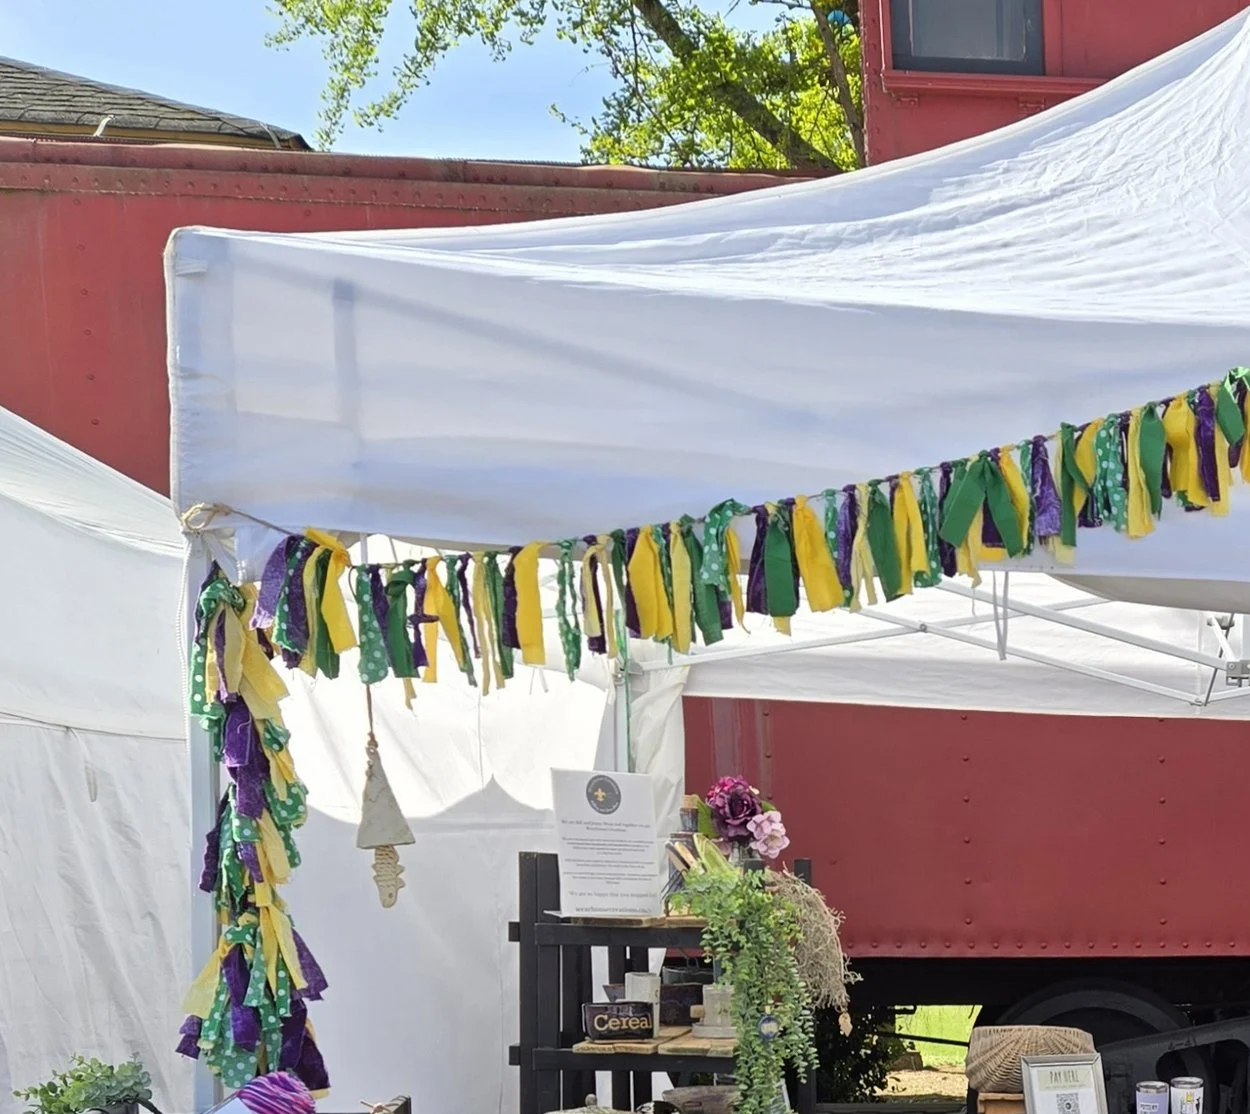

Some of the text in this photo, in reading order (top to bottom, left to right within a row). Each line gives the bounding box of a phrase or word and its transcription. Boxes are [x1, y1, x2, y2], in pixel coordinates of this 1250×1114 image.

[594, 1014, 653, 1032] Cereal
[1049, 1069, 1080, 1084] PAY HERE
